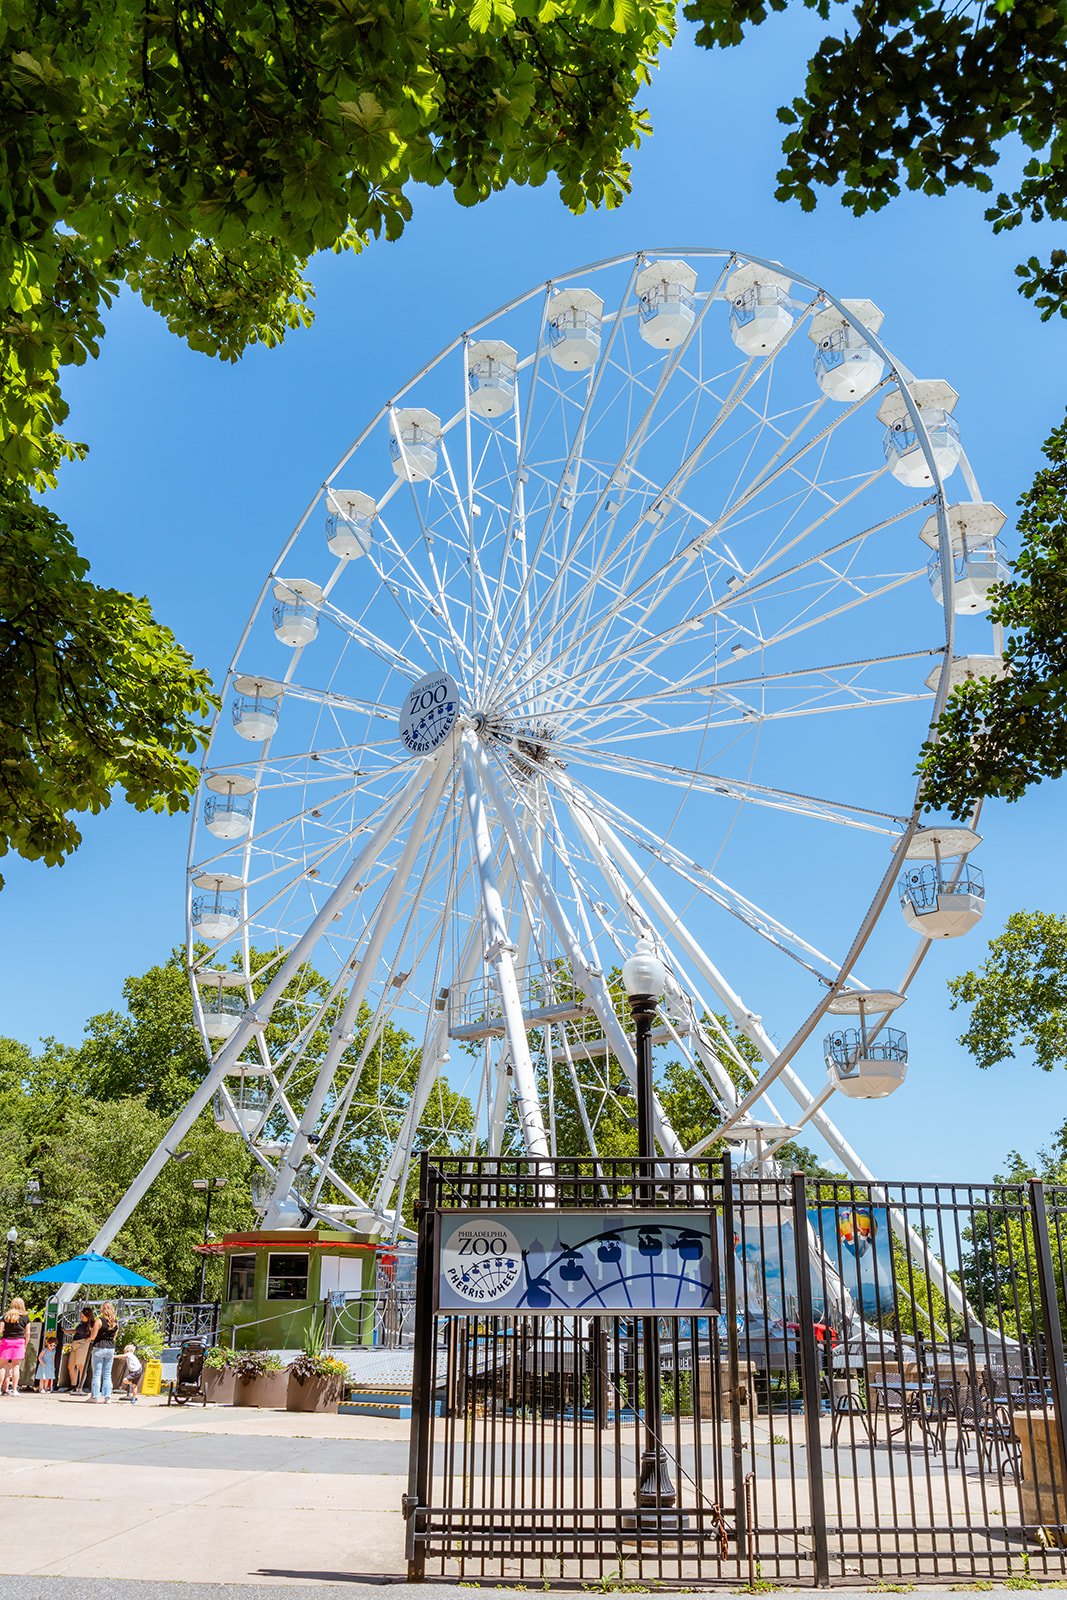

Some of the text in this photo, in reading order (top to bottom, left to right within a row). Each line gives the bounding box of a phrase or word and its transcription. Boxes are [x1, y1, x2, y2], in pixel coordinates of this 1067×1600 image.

[410, 684, 448, 715] ZOO
[402, 711, 455, 752] PHERRIS WHEEL
[458, 1237, 507, 1256] ZOO
[447, 1268, 518, 1299] PHERRIS WHEEL
